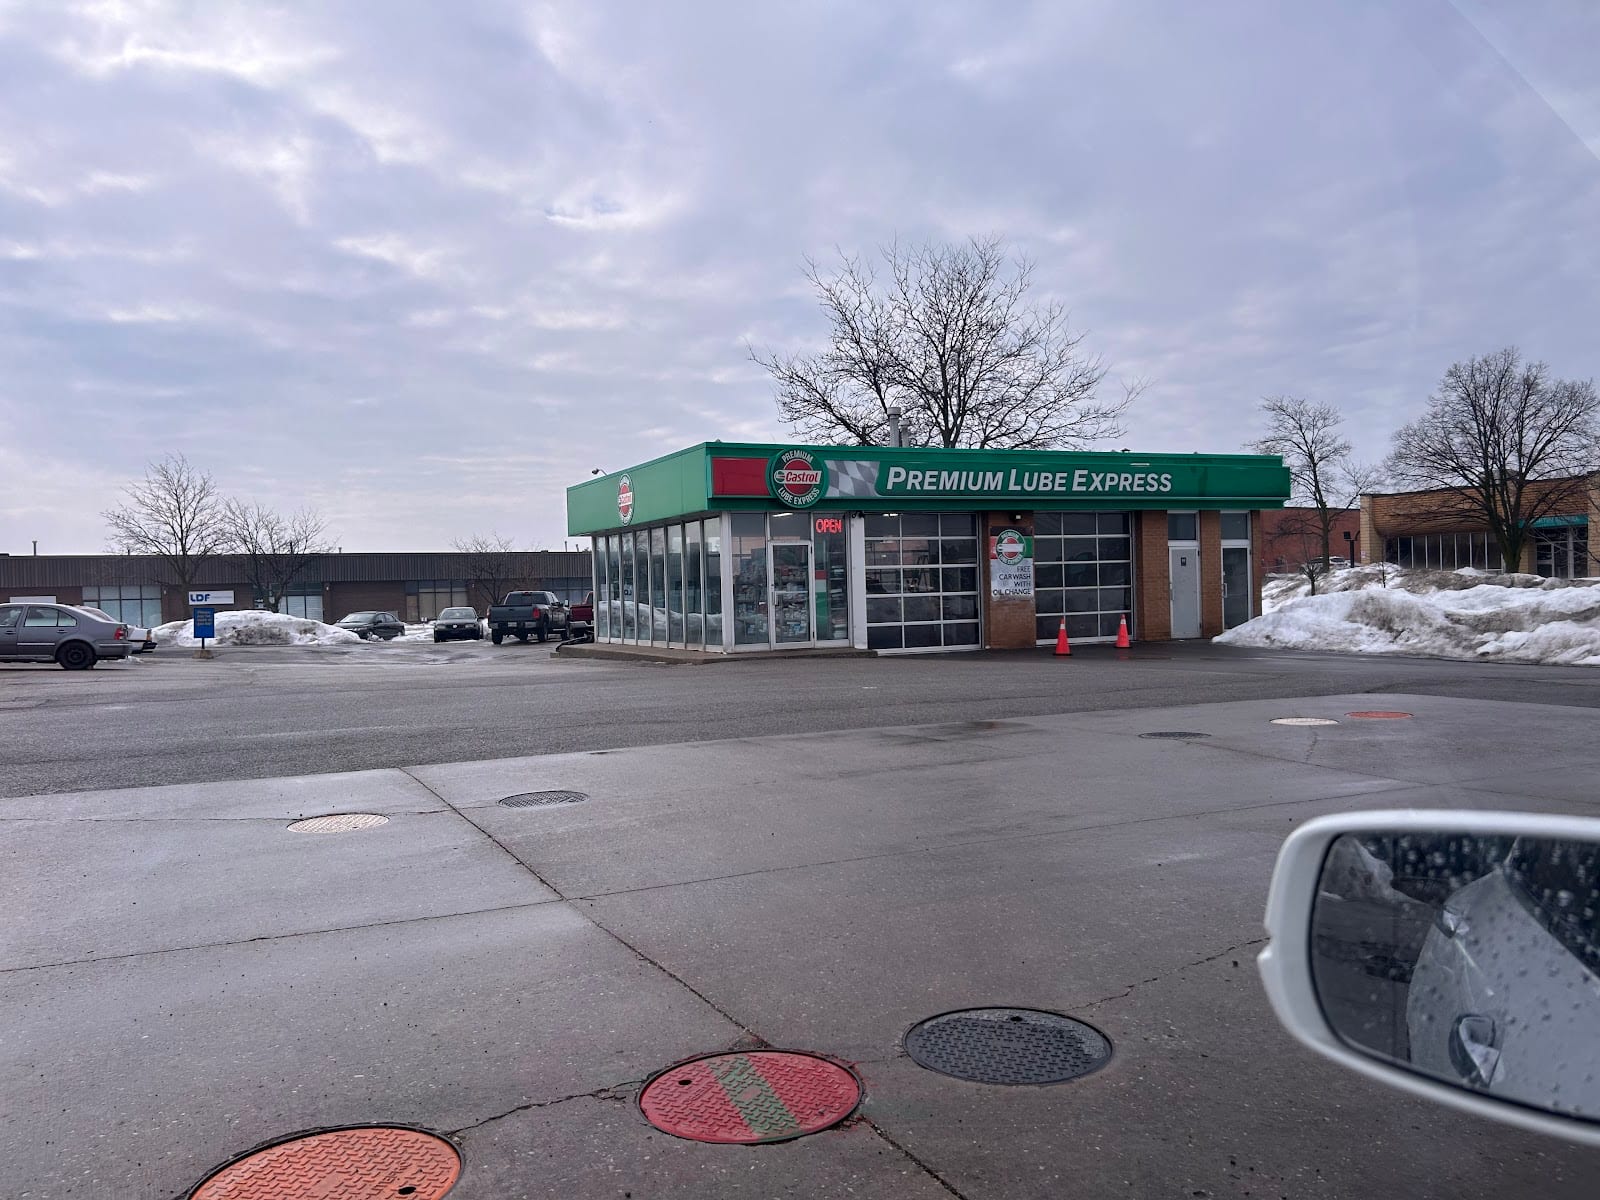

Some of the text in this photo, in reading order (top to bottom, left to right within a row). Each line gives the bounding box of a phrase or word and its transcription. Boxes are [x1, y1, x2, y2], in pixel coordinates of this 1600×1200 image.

[781, 450, 814, 463] PREMIUM
[785, 471, 819, 483] Castrol
[886, 466, 1172, 492] PREMIUM LUBE EXPRESS
[777, 487, 820, 505] LUBE EXPRESS
[815, 518, 842, 533] OPEN
[190, 594, 210, 602] LDF
